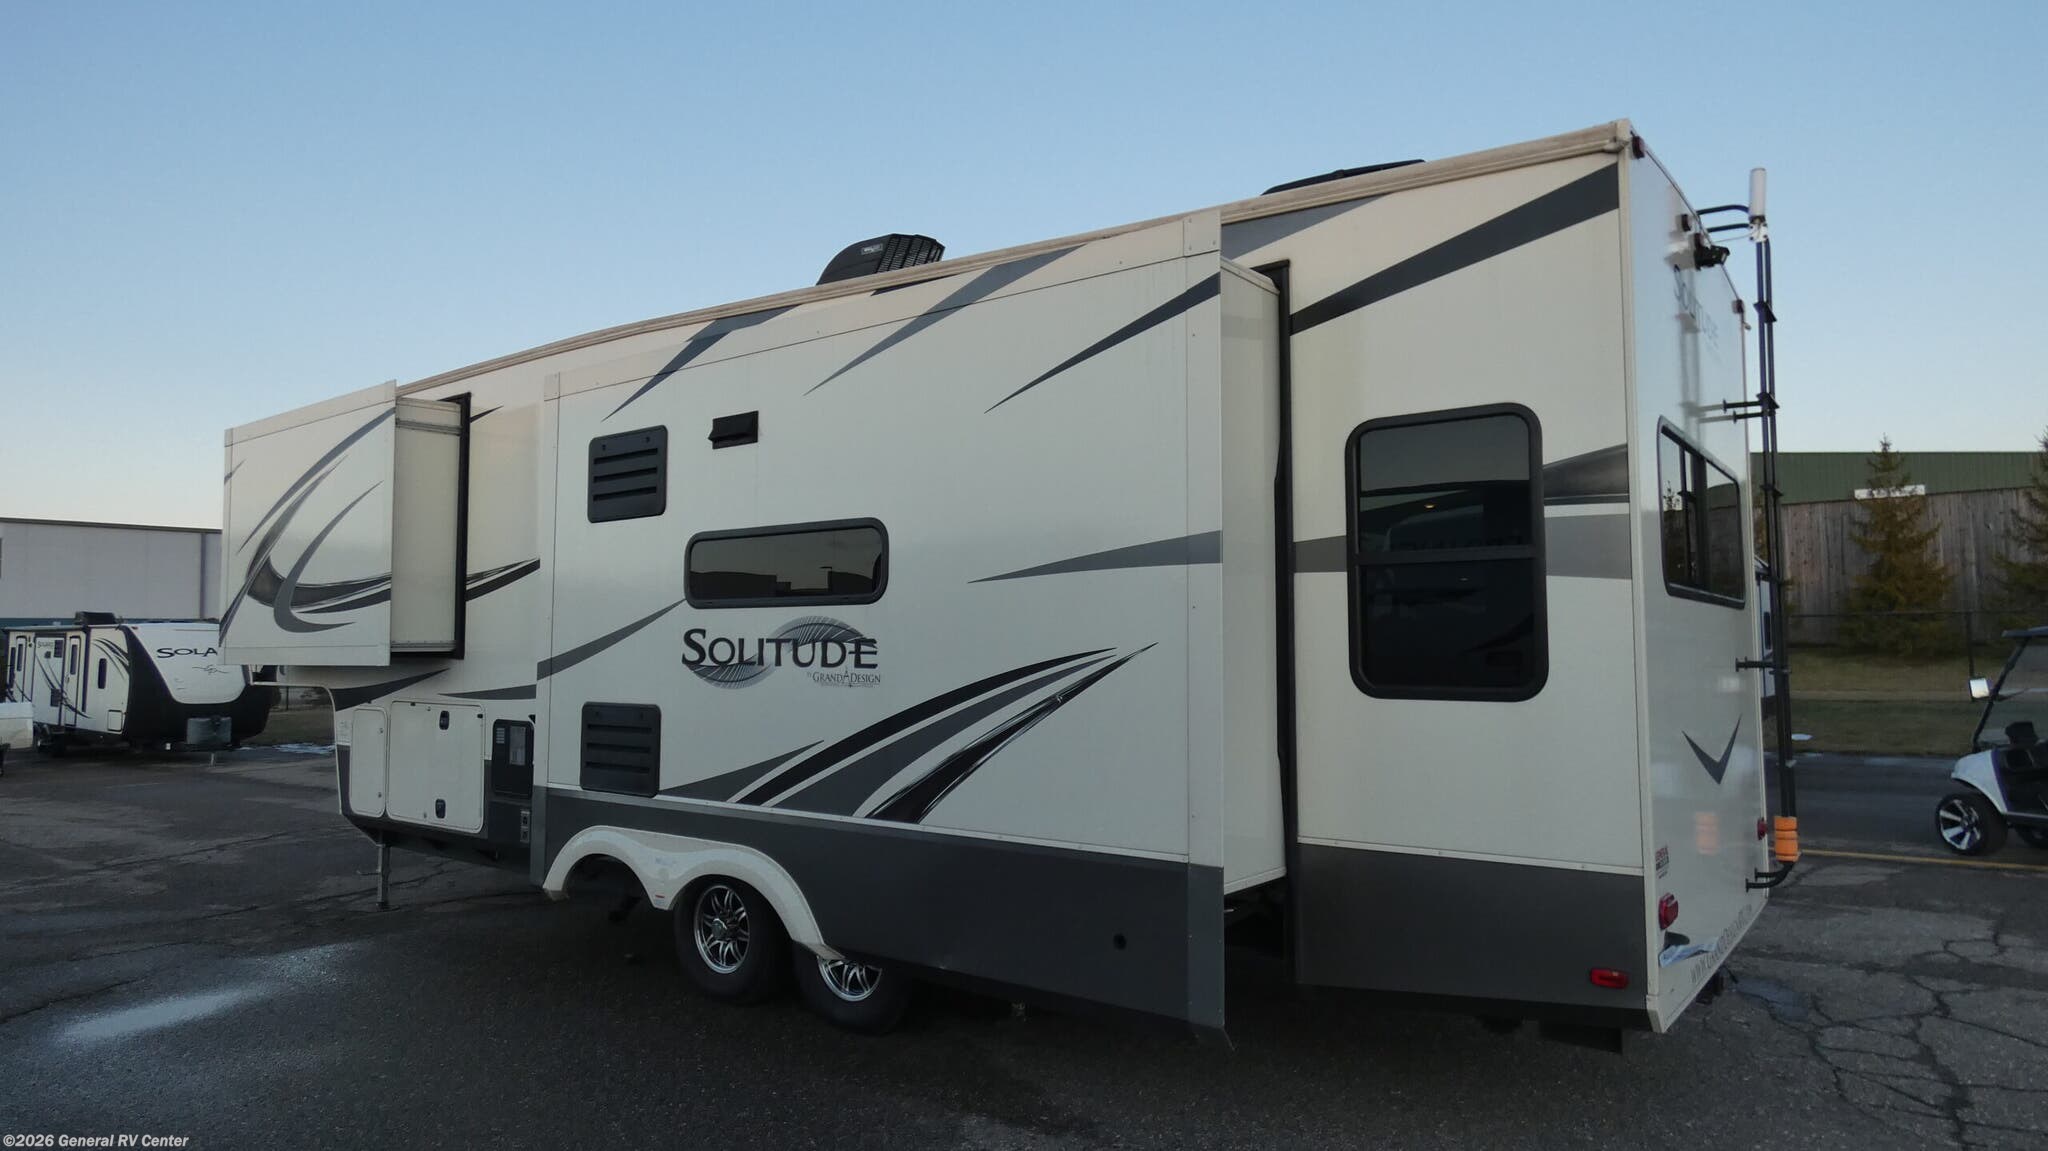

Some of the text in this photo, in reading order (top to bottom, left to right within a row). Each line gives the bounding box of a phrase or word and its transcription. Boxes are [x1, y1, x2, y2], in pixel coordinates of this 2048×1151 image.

[157, 647, 218, 658] SOLA
[681, 628, 878, 669] SOLITUDE
[812, 671, 843, 683] GRAND
[850, 672, 881, 683] DESIGN
